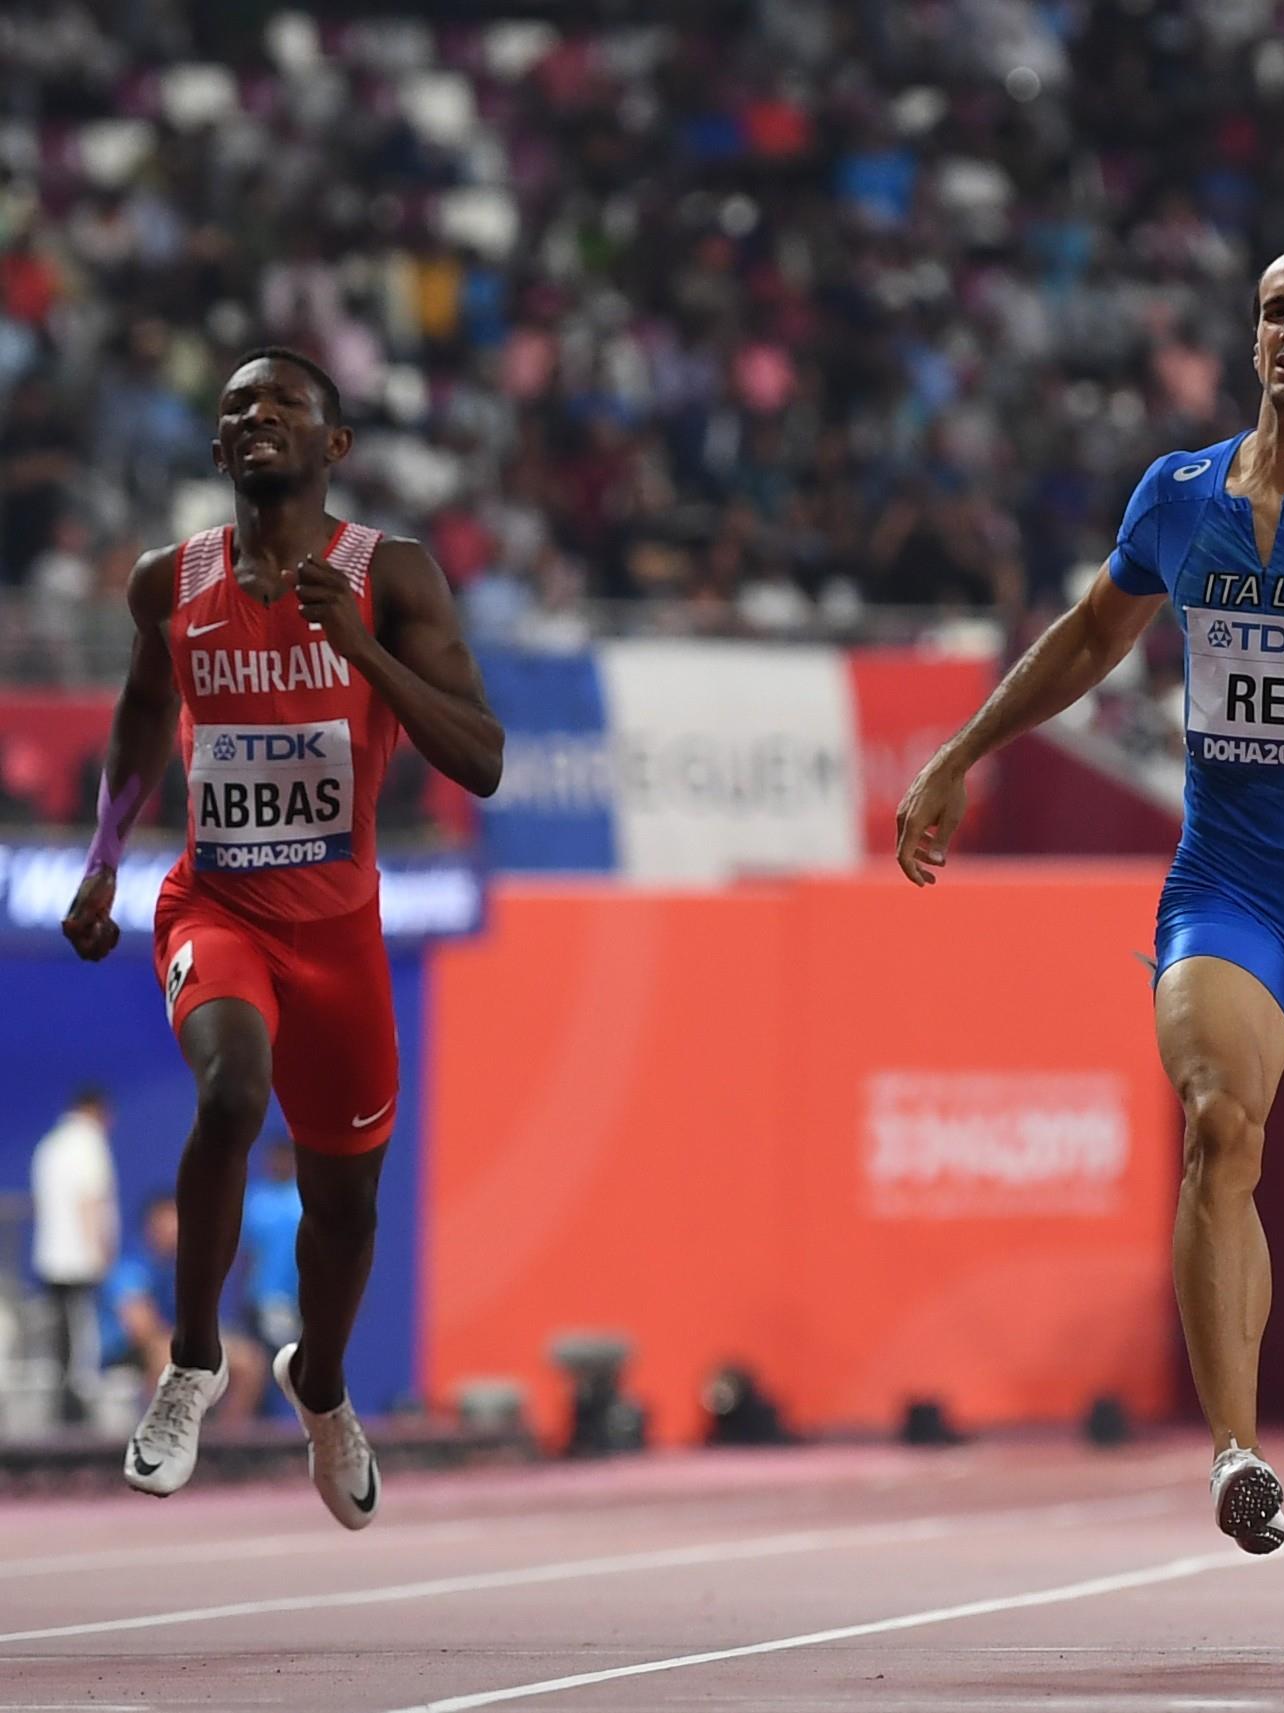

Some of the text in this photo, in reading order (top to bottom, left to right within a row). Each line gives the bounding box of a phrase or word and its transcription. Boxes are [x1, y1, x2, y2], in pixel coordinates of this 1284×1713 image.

[191, 640, 350, 697] BAHRAIN
[236, 731, 327, 761] TDK
[200, 777, 341, 829] ABBAS
[216, 840, 327, 868] DOHA2019
